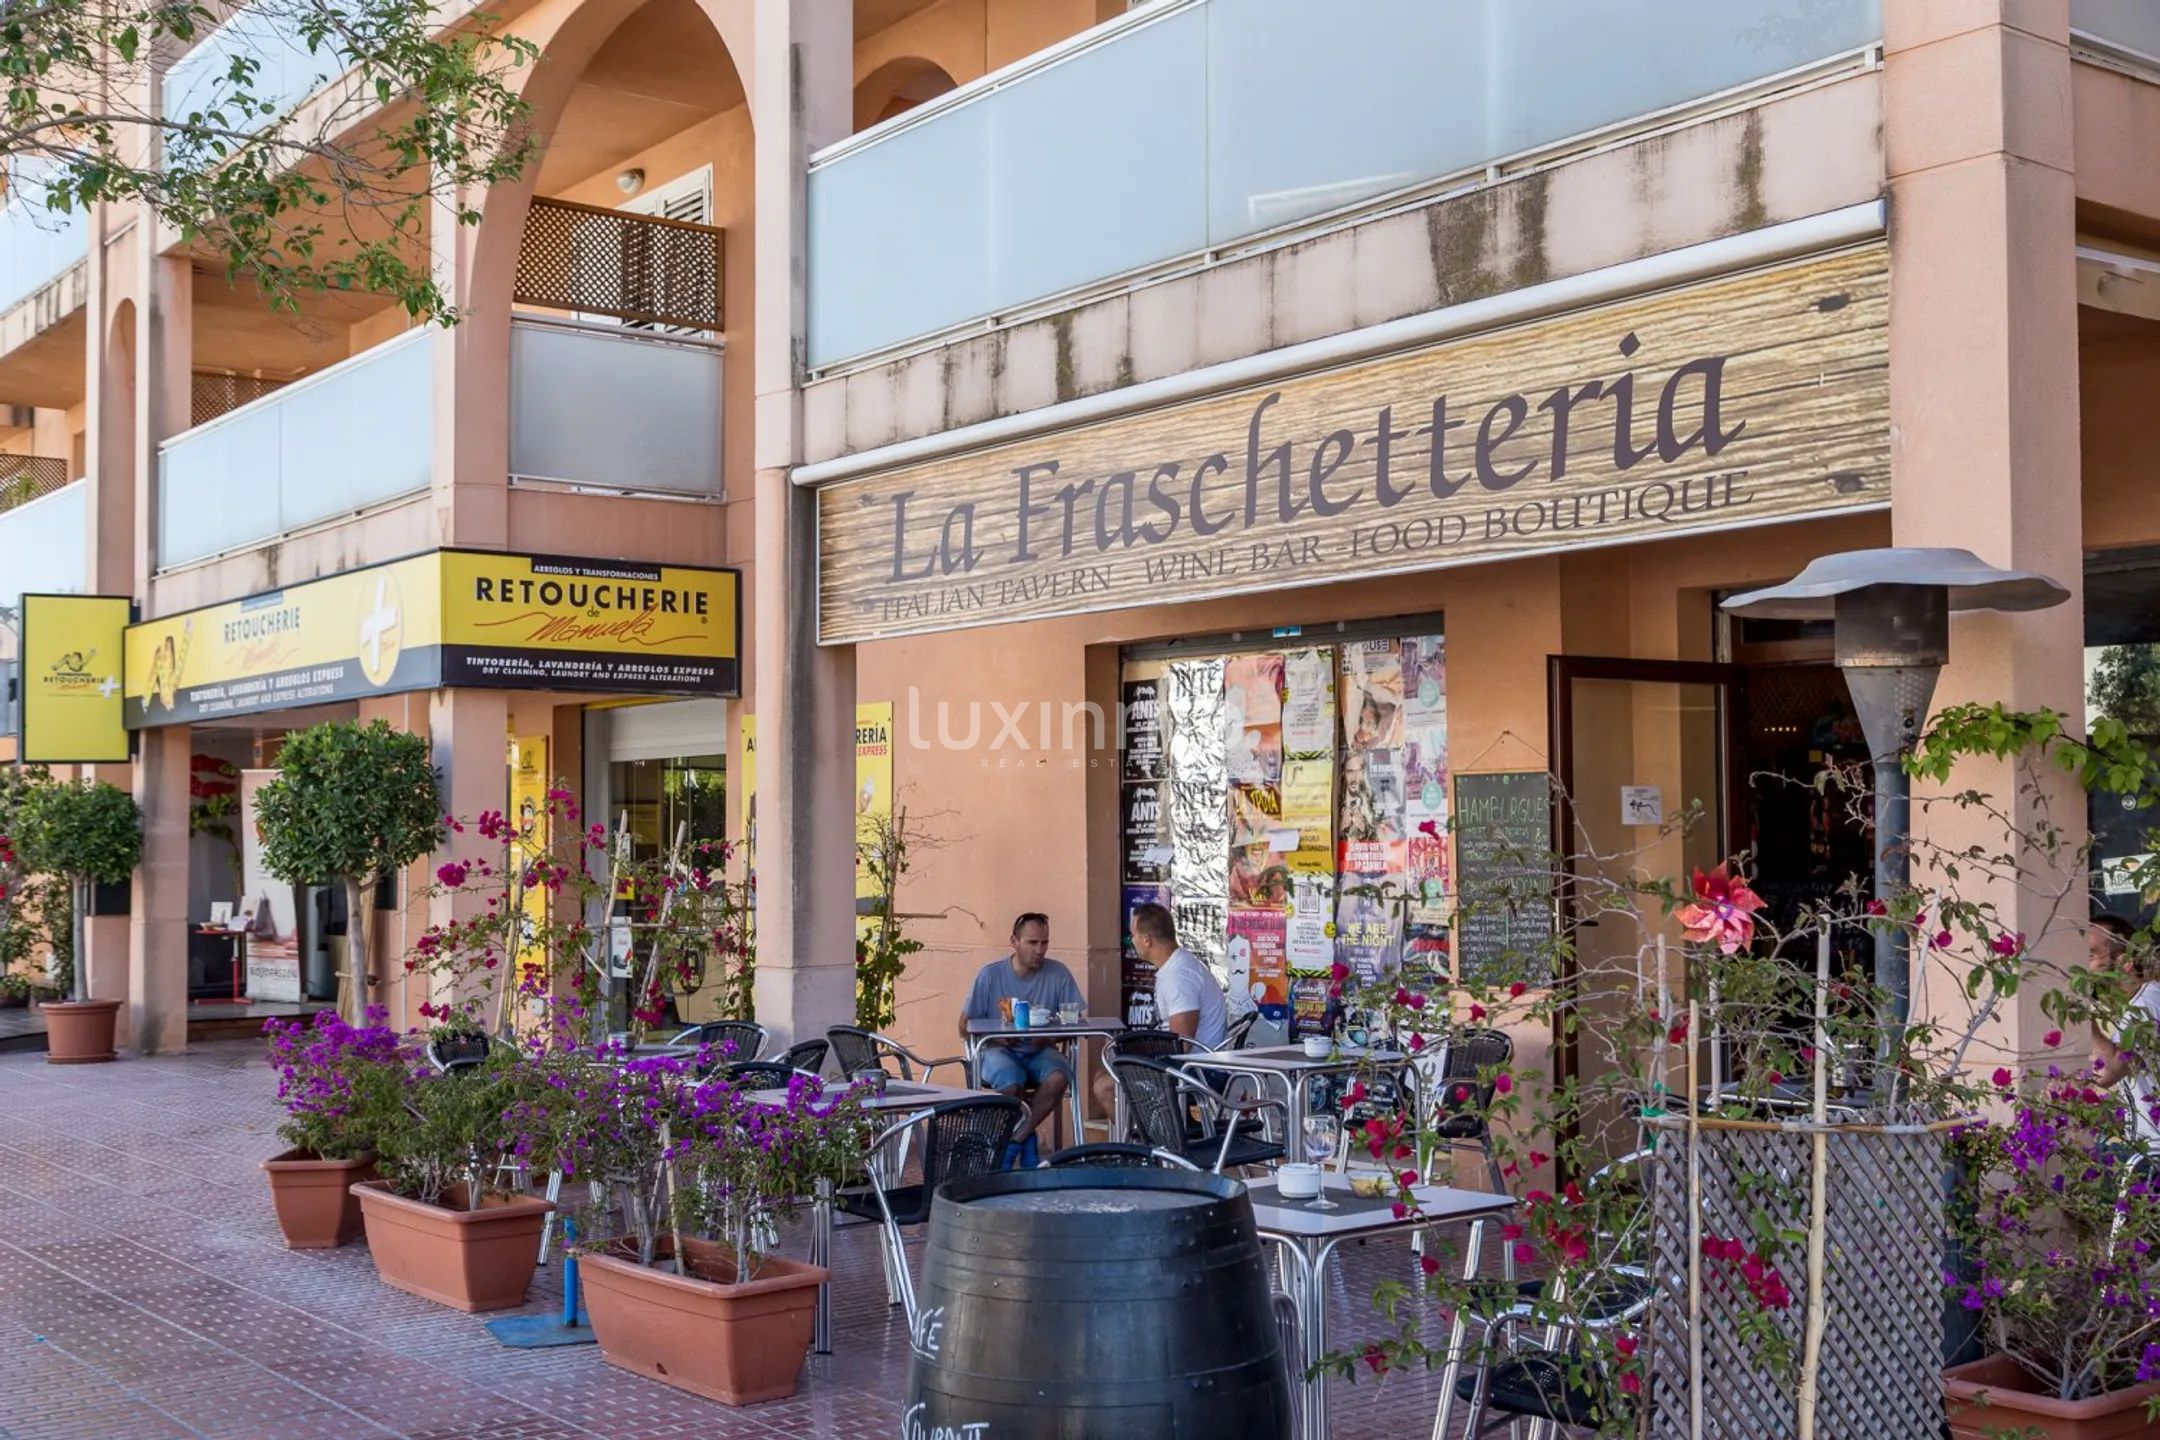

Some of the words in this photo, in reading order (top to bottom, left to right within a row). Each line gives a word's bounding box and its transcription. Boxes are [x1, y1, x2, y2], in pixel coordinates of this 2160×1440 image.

[886, 490, 984, 584] La
[1009, 331, 1747, 563] Fraschetteria
[881, 583, 985, 622] ITALIAN
[994, 564, 1113, 605] TAVERN
[1144, 547, 1238, 584] WINE
[1249, 534, 1325, 573] BAR
[1484, 470, 1755, 541] BOUTIQUE
[534, 565, 573, 575] ARREGLOS
[575, 567, 581, 575] Y
[582, 568, 659, 581] TRANSFORMACIONES
[475, 576, 708, 614] RETOUCHERIE
[587, 606, 600, 617] de
[223, 606, 301, 644] RETOUCHERIE
[312, 666, 344, 685] EXPRESS
[482, 667, 499, 675] DRY
[551, 670, 589, 678] LAUNDRY
[592, 671, 610, 679] AND
[613, 672, 647, 680] EXPRESS
[649, 674, 701, 683] ALTERATIONS
[538, 659, 602, 671] LAVANDERÍA
[607, 663, 614, 671] Y
[618, 663, 669, 674] ARREGLOS
[673, 666, 715, 676] EXPRESS
[1131, 700, 1161, 720] ANTS
[1131, 801, 1161, 822] ANTS
[1362, 935, 1394, 947] NIGHT
[1127, 1005, 1154, 1025] ANTS
